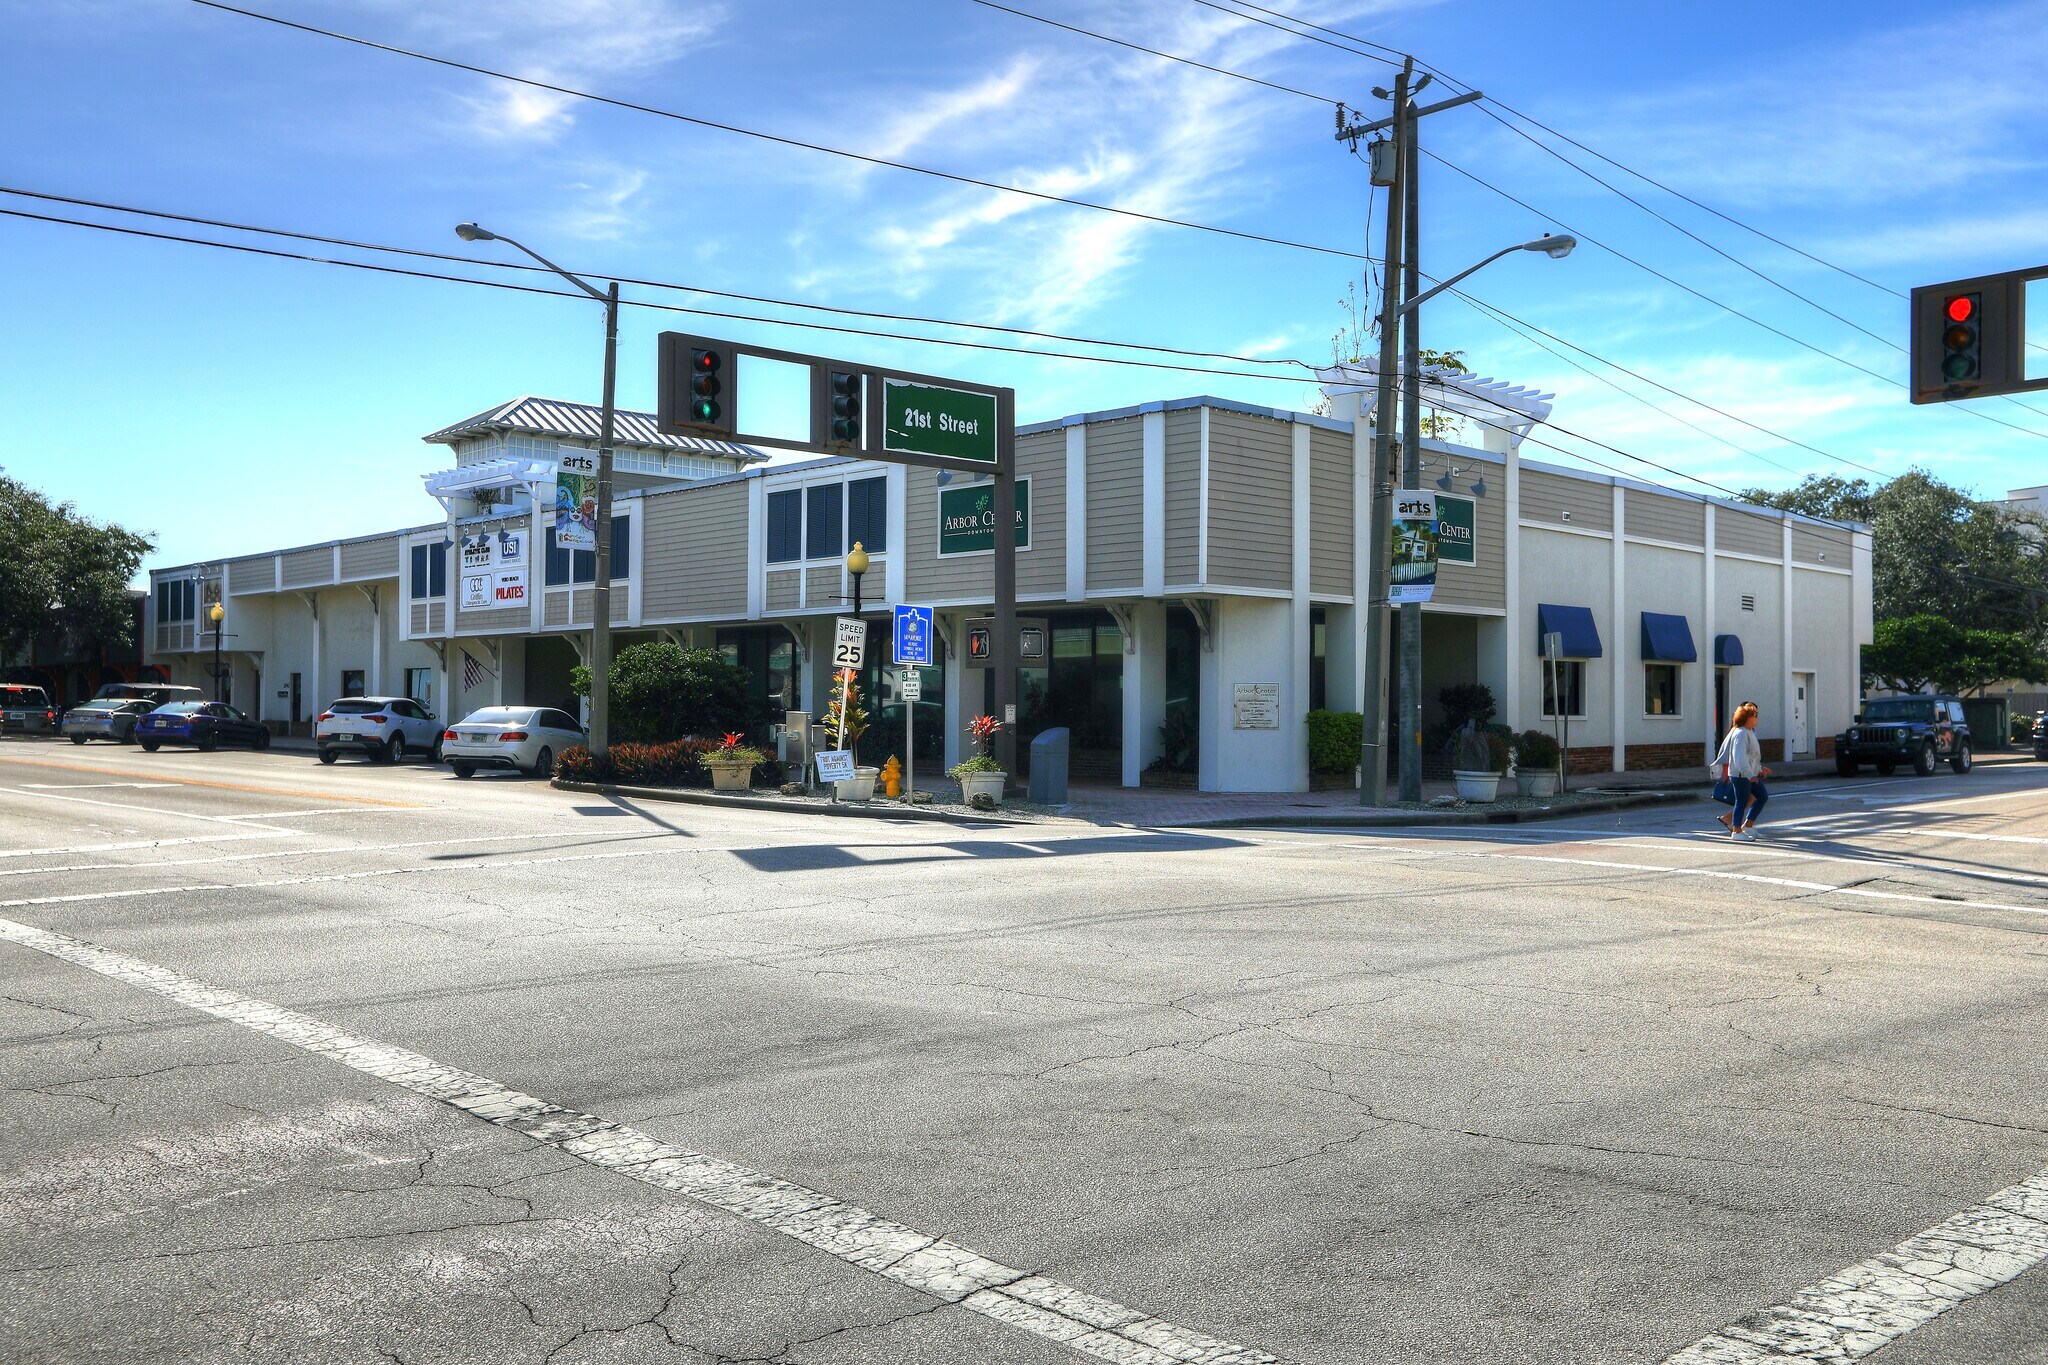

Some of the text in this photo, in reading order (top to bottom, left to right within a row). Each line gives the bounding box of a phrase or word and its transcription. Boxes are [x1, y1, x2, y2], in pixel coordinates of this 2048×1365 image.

[904, 407, 979, 436] 21st Street
[563, 456, 593, 470] arts
[1398, 500, 1431, 514] arts
[944, 510, 1023, 531] ARBOR CER
[967, 528, 995, 536] DOWNTOW
[1439, 521, 1471, 539] CENTER
[503, 541, 517, 555] USI
[495, 585, 524, 600] PILATES
[839, 623, 864, 634] SPEED
[840, 633, 861, 644] LIMIT
[836, 644, 861, 664] 25
[902, 672, 907, 681] 3
